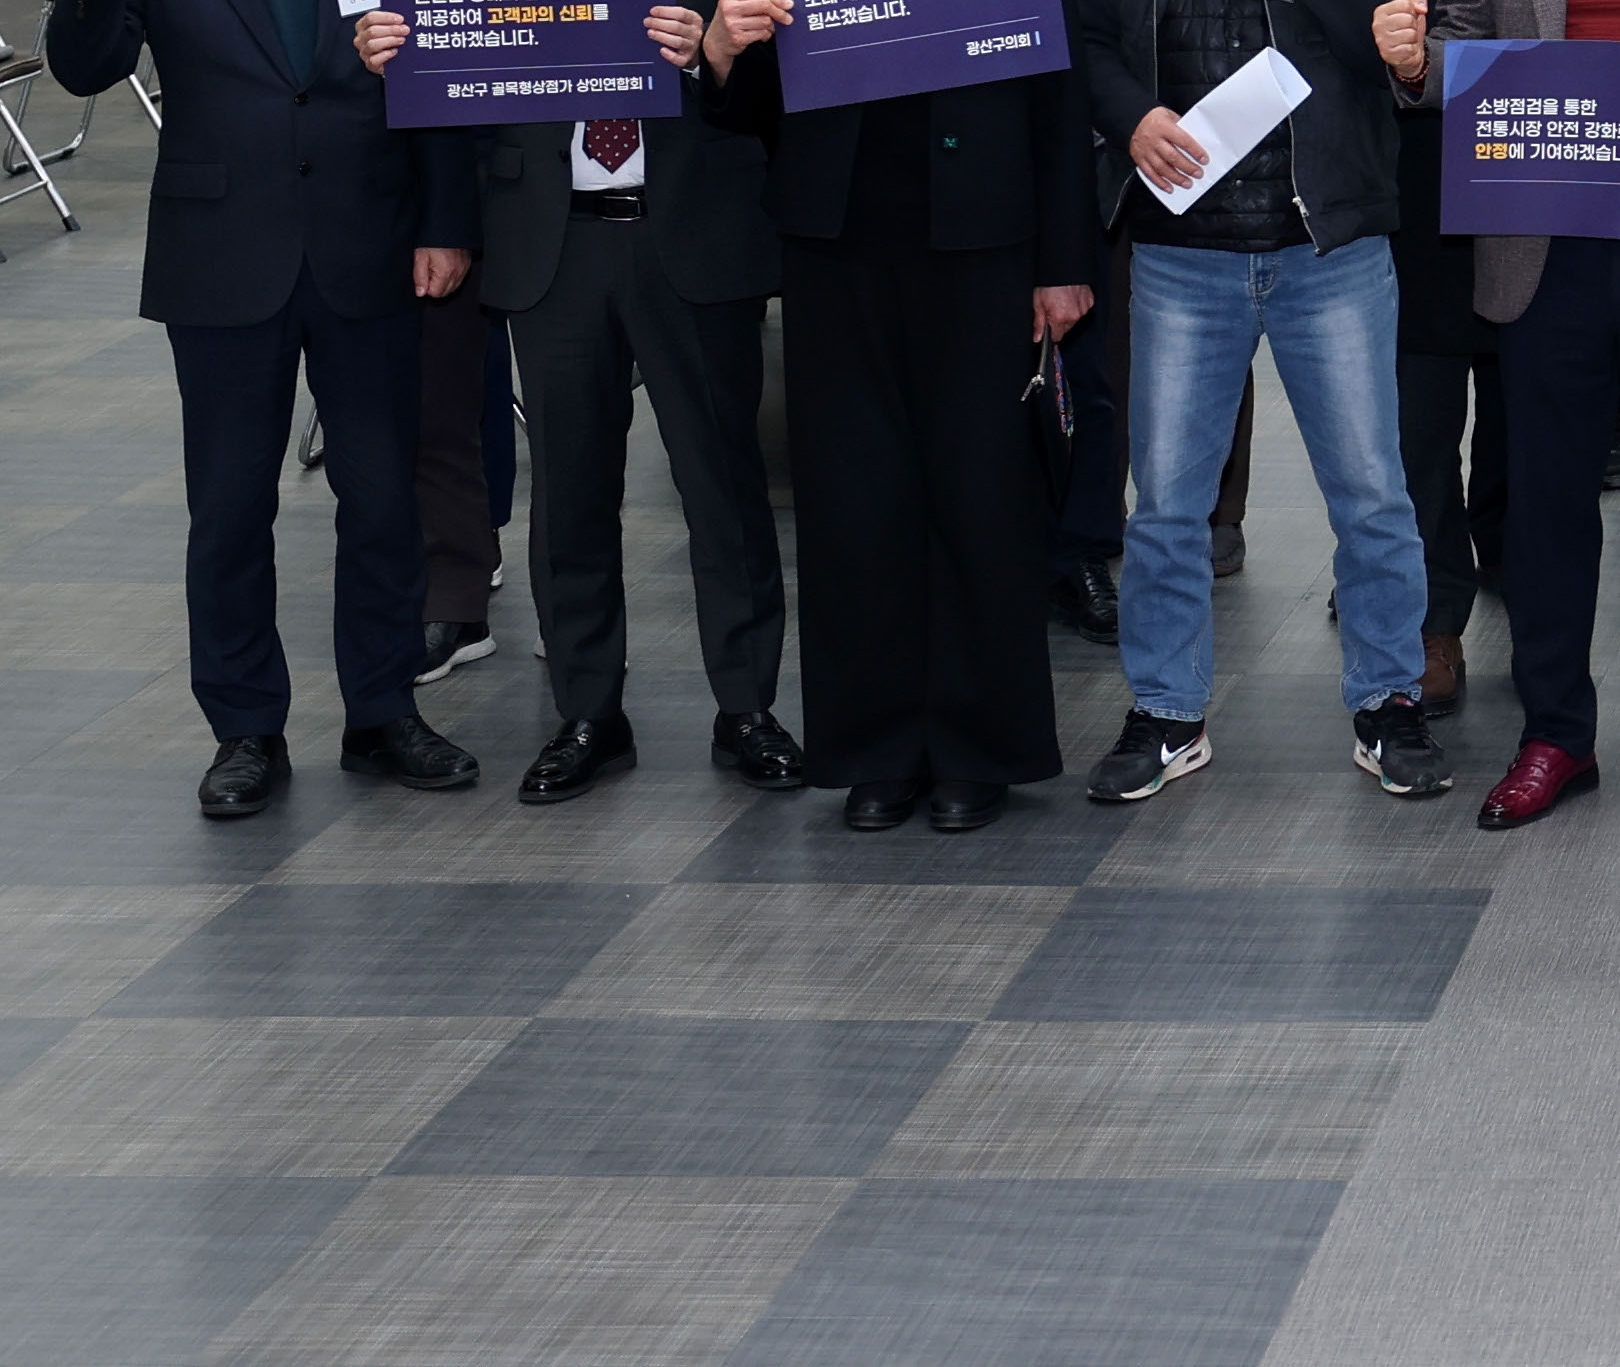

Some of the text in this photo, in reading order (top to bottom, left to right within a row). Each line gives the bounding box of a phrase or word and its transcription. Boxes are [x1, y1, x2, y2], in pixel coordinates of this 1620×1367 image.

[415, 4, 609, 27] 제공하여 고객과의 신뢰를
[806, 0, 912, 32] 힘쓰겠습니다.
[416, 28, 539, 50] 확보하겠습니다.
[966, 33, 1032, 57] 광산구의회
[447, 76, 643, 99] 광산구 골목형상점가 상인연합회
[1476, 98, 1598, 116] 소방점검을 통한
[1476, 120, 1542, 138] 전통시장
[1546, 121, 1580, 139] 안전
[1475, 142, 1525, 160] 안정에
